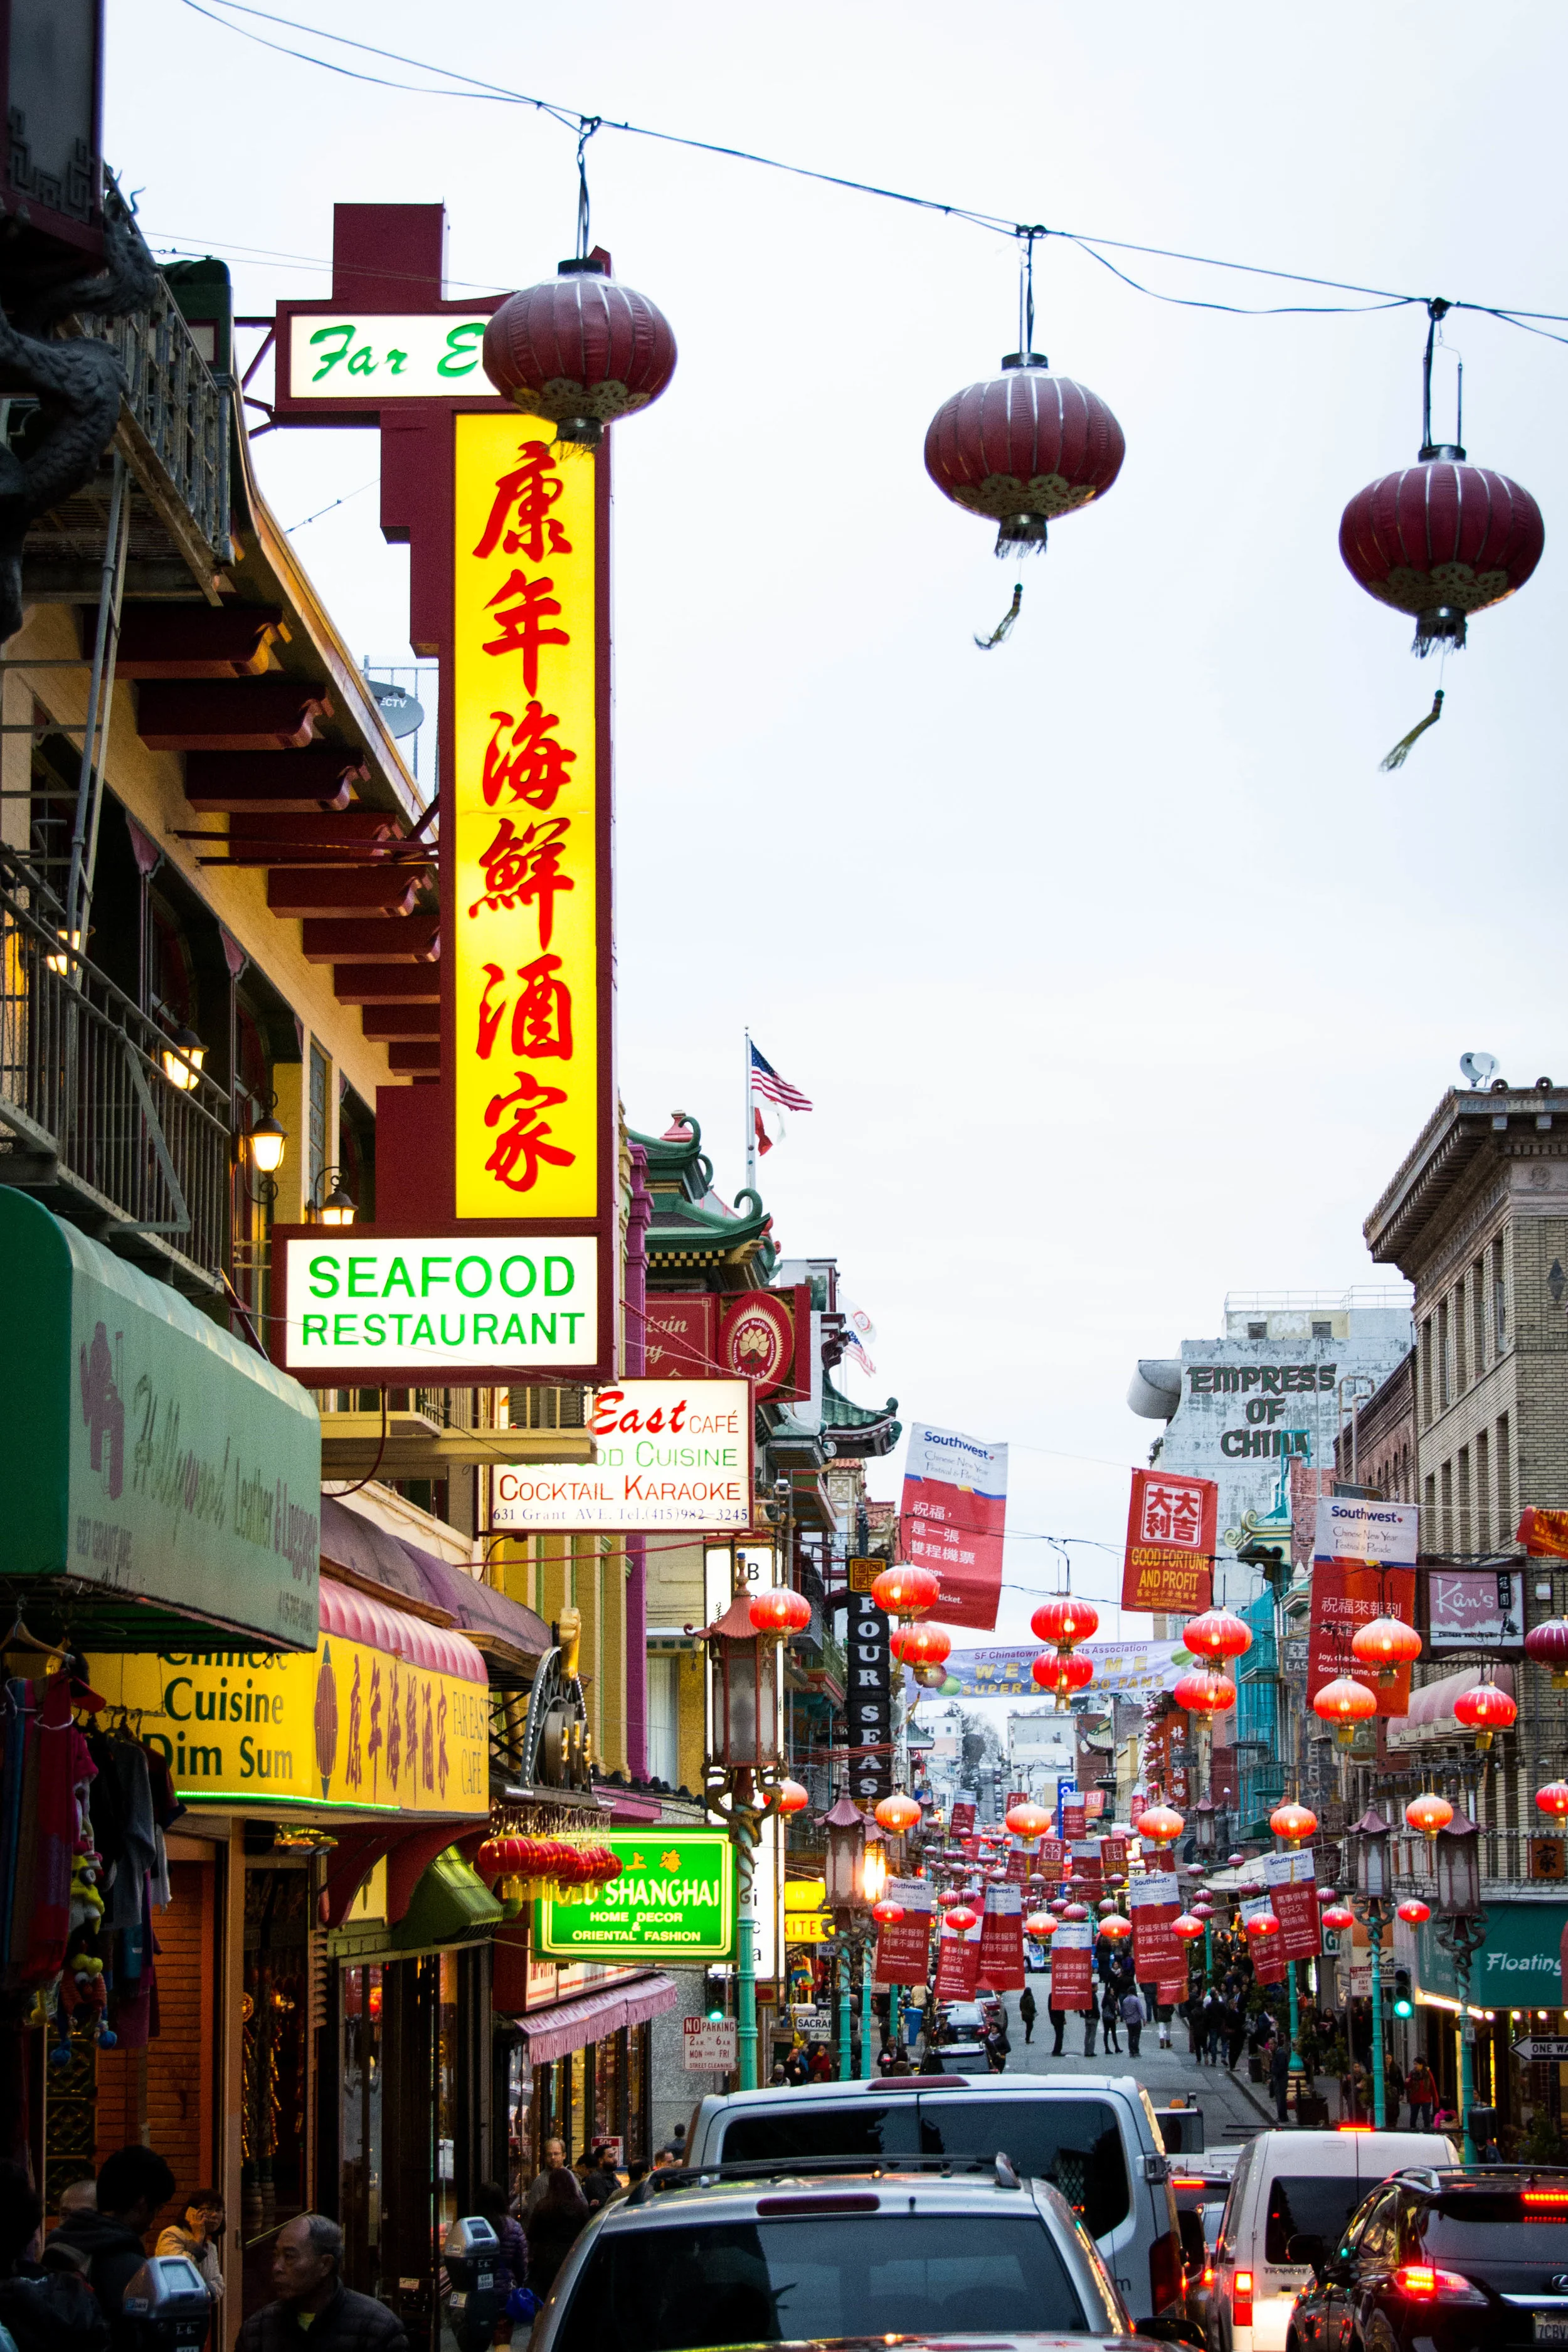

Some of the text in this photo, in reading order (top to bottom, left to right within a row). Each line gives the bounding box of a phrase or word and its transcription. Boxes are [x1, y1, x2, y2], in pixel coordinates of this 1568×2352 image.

[310, 324, 408, 381] Far
[469, 441, 576, 1192] 康年海鮮酒家
[309, 1255, 576, 1298] SEAFOOD
[302, 1312, 585, 1347] RESTAURANT
[1186, 1363, 1337, 1395] EMPRESS
[591, 1391, 739, 1435] East CAFÉ
[1246, 1397, 1286, 1425] OF
[636, 1441, 738, 1468] CUISINE
[924, 1431, 989, 1460] Southwest
[1221, 1429, 1313, 1459] CHINA
[499, 1474, 741, 1501] COCKTAIL KARAOKE
[493, 1508, 515, 1521] 631
[522, 1508, 566, 1521] Grant
[576, 1508, 613, 1522] AVE.
[1331, 1505, 1397, 1523] Southwest
[1333, 1526, 1399, 1542] Chinese New Year
[1335, 1539, 1360, 1551] Festival
[1367, 1542, 1391, 1554] Parade
[1131, 1547, 1210, 1572] GOOD FORTUNE
[1139, 1569, 1199, 1591] AND PROFIT
[1435, 1576, 1494, 1617] Kan's
[974, 1651, 987, 1660] SF
[988, 1650, 1039, 1660] Chinatown
[1091, 1644, 1148, 1655] Association
[1318, 1652, 1333, 1662] Joy,
[1318, 1665, 1338, 1673] Good
[858, 1596, 884, 1795] FOUR SEAS
[961, 1682, 1022, 1695] SUPER
[1089, 1678, 1111, 1691] 50
[1118, 1675, 1165, 1689] FANS
[164, 1677, 284, 1724] Cuisine
[452, 1690, 469, 1740] FAR
[142, 1731, 293, 1779] Dim Sum
[461, 1747, 482, 1796] CAFE
[605, 1878, 719, 1907] SHANGHAI
[1134, 1877, 1167, 1887] Southwest
[590, 1912, 683, 1922] HOME DECOR
[632, 1921, 641, 1931] &
[785, 1921, 824, 1936] KITE
[572, 1930, 701, 1942] ORIENTAL FASHION
[1486, 1952, 1562, 1976] Floating
[686, 2018, 734, 2032] NO PARKING
[797, 2018, 832, 2028] SACRA
[689, 2049, 703, 2058] MON
[719, 2049, 729, 2058] FRI
[1532, 2043, 1568, 2053] ONE WA
[1538, 2315, 1567, 2339] 7CBV
